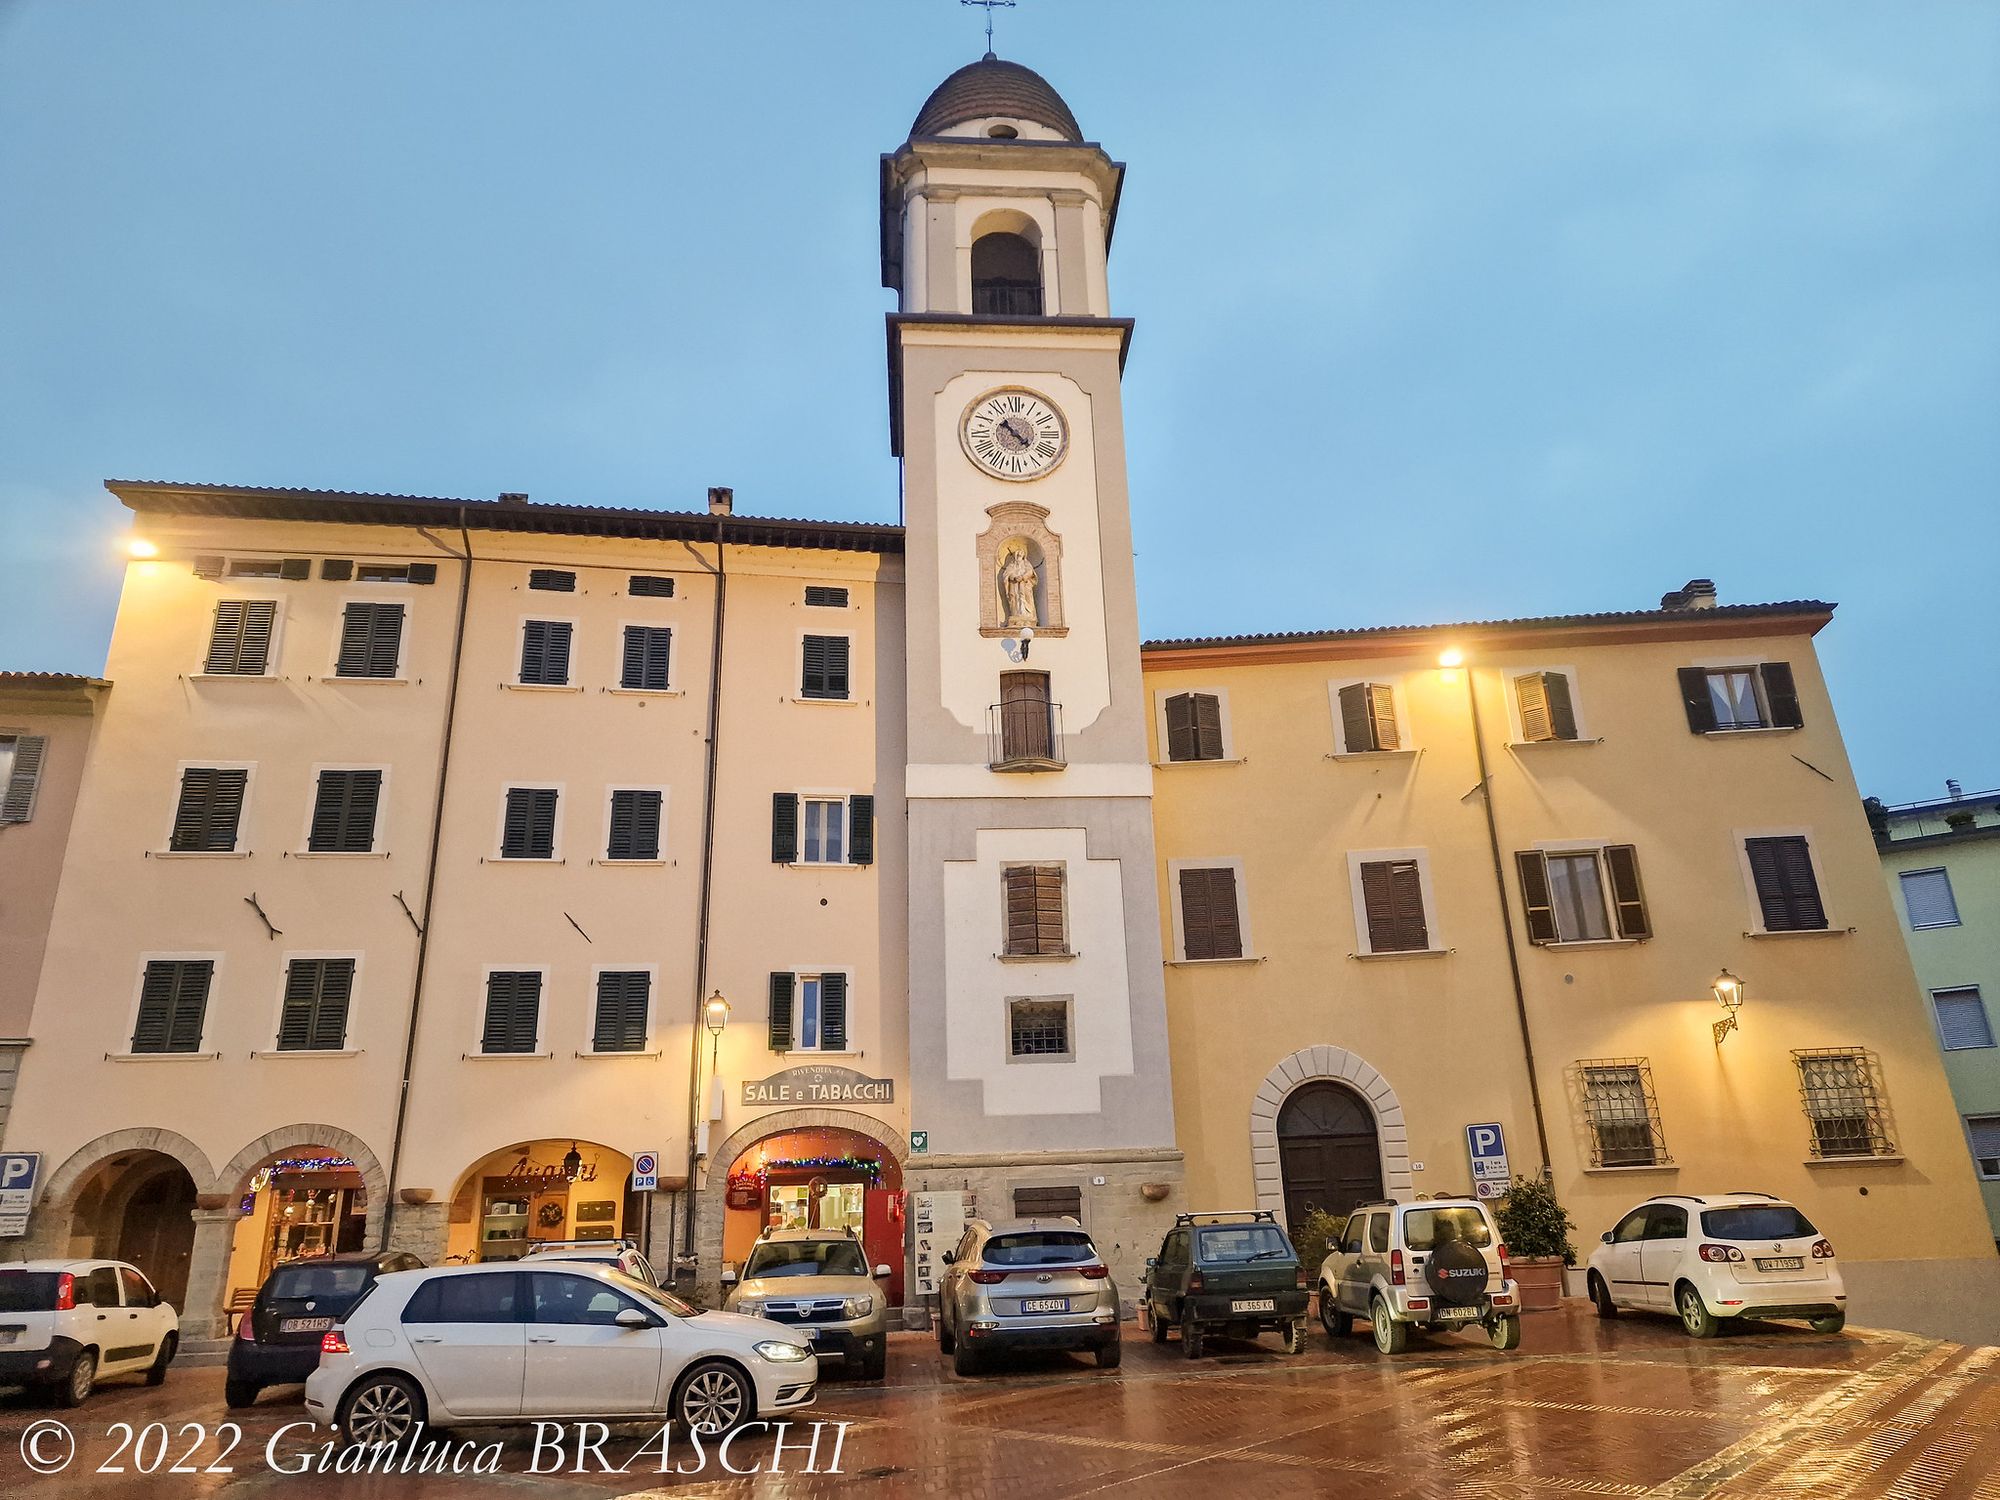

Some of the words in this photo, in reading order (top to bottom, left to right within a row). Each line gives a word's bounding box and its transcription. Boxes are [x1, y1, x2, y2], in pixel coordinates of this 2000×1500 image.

[745, 1085, 790, 1101] SALE
[796, 1091, 804, 1100] e
[808, 1083, 890, 1100] TABACCHI
[1475, 1128, 1496, 1155] P
[2, 1158, 29, 1187] P
[637, 1178, 643, 1186] P
[1448, 1268, 1486, 1278] SUZUKI
[1247, 1301, 1261, 1310] 365
